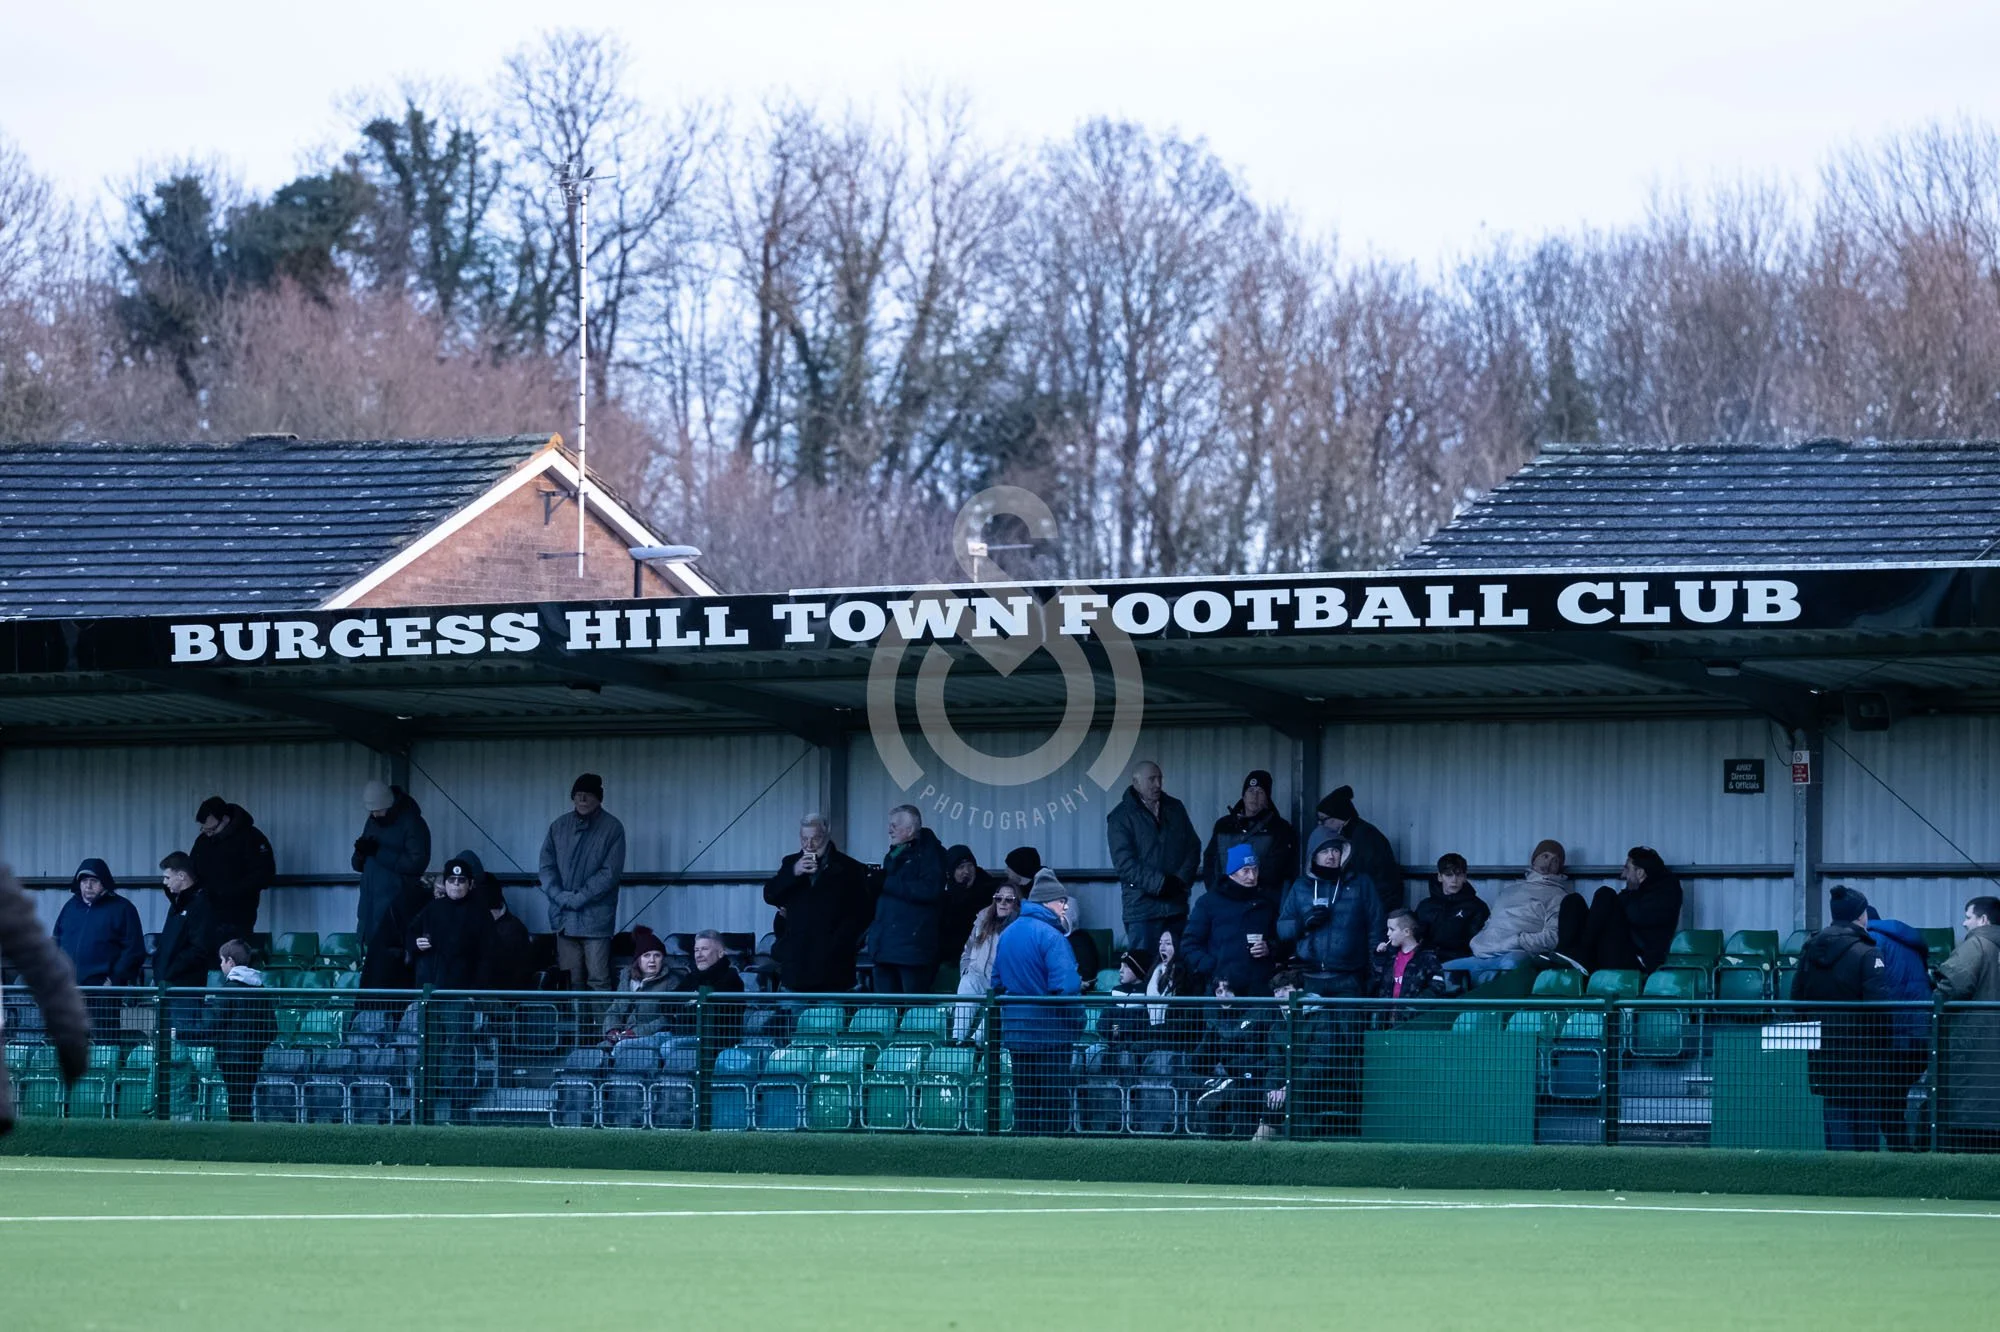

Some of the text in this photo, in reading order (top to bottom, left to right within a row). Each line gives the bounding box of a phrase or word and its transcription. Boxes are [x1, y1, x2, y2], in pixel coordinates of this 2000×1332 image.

[170, 580, 1802, 662] BURGESS HILL TOWN FOOTBALL CLUB
[1730, 772, 1757, 780] Directors
[1735, 781, 1760, 789] Officials
